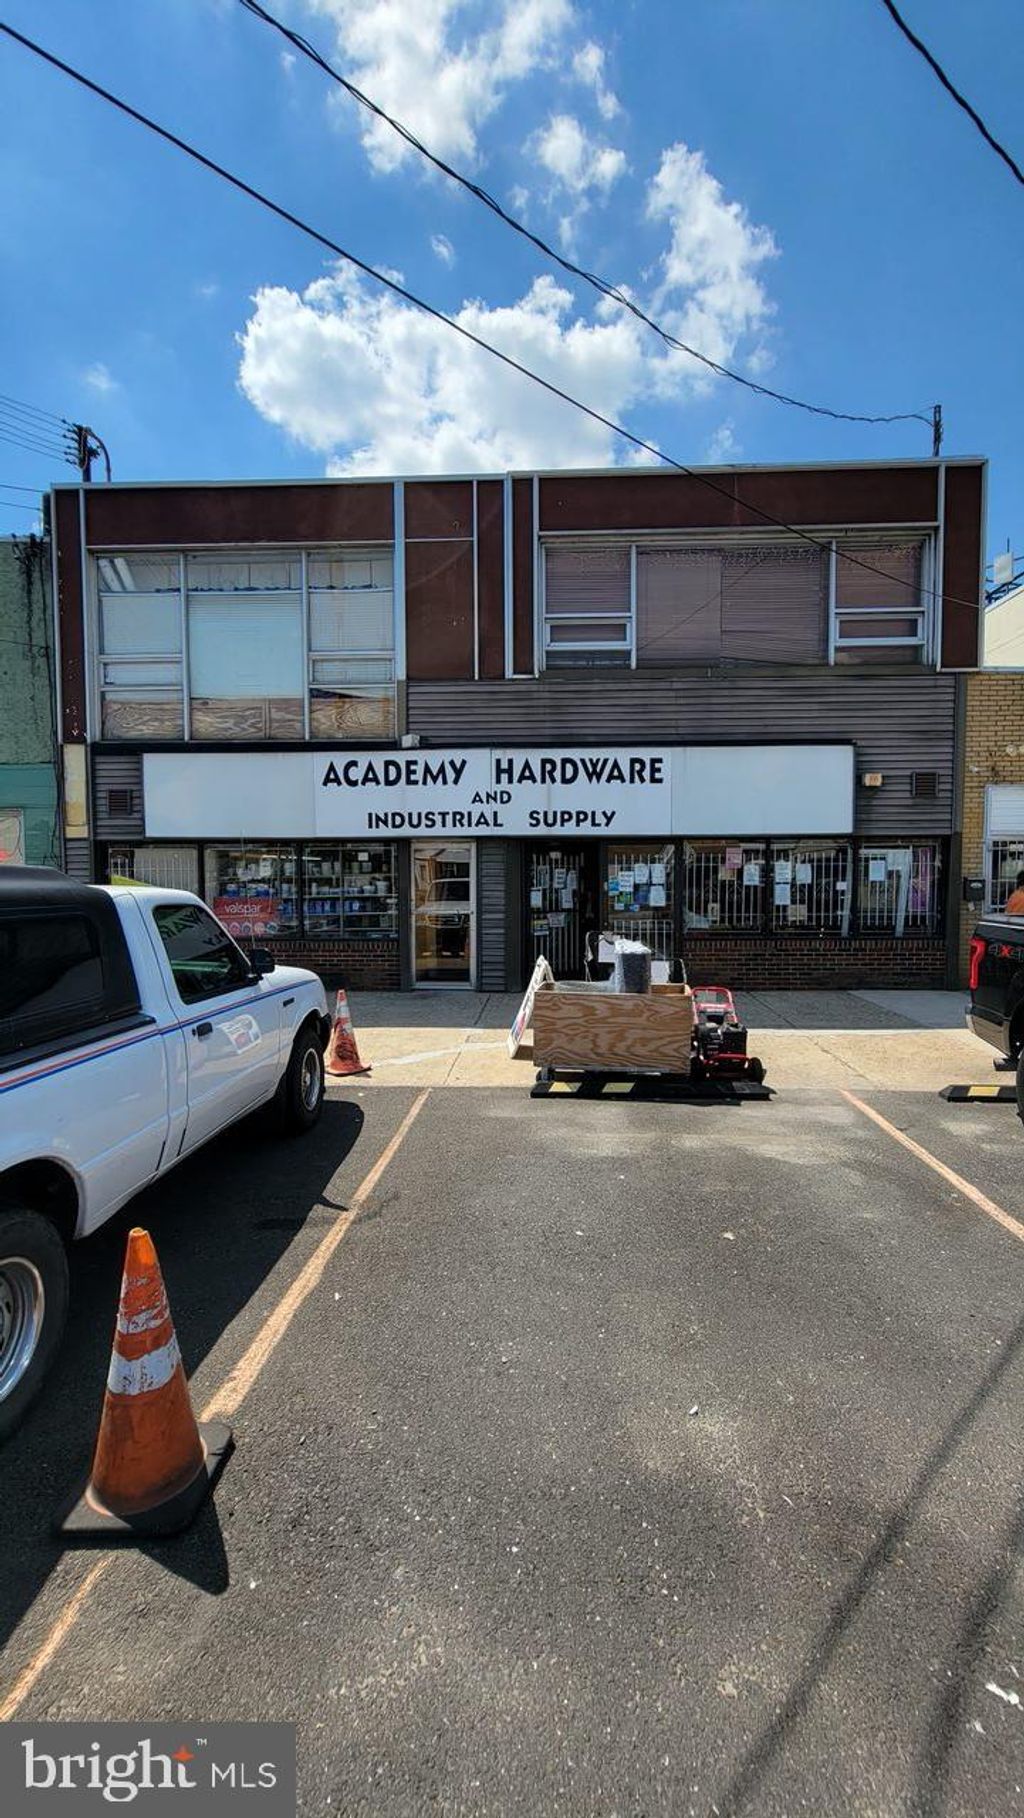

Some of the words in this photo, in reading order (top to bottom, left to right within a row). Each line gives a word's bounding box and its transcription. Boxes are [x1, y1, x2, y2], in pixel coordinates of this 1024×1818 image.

[322, 758, 467, 787] ACADEMY
[495, 757, 664, 785] HARDWARE
[471, 790, 512, 804] AND
[367, 810, 504, 829] INDUSTRIAL
[528, 810, 616, 828] SUPPLY
[225, 902, 262, 916] valspar
